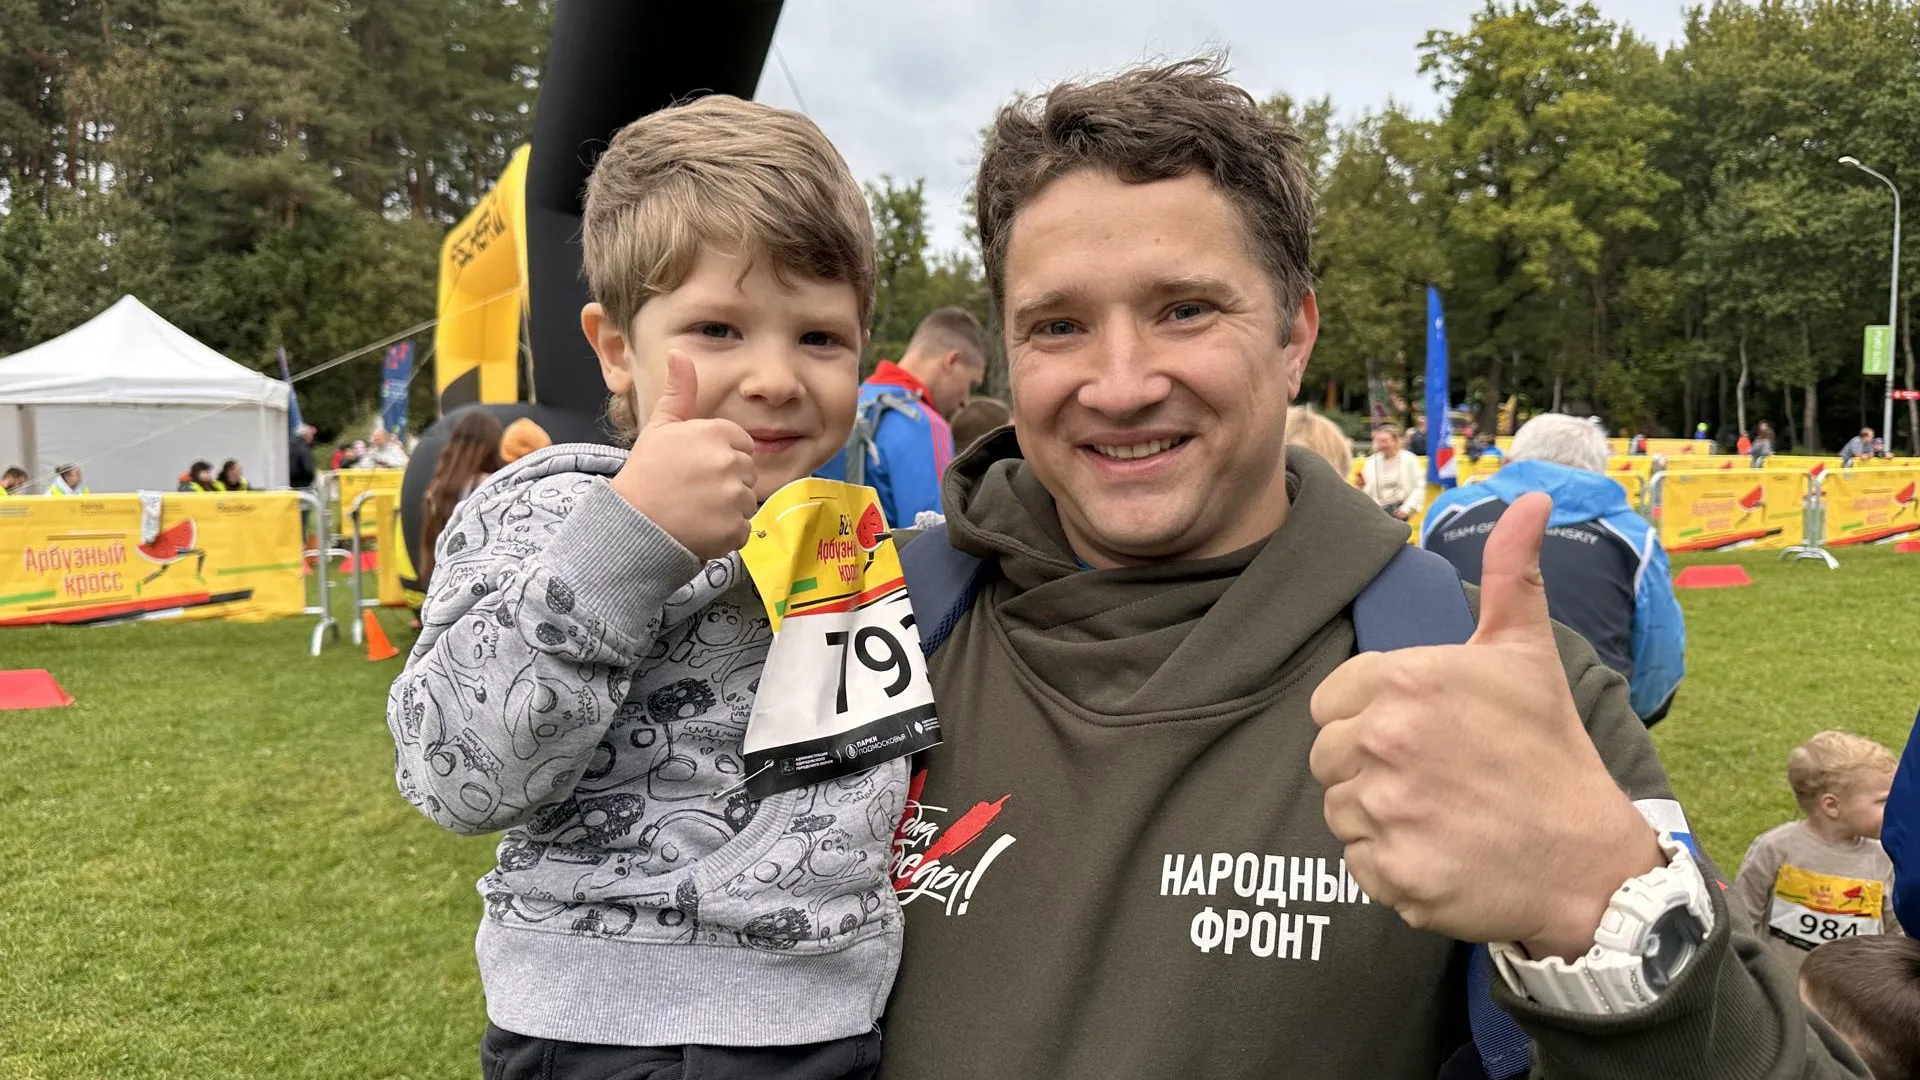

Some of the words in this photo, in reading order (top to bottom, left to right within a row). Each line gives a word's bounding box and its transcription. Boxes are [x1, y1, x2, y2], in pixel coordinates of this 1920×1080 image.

[24, 540, 127, 575] Арбузный
[64, 571, 124, 598] кросс
[856, 735, 878, 748] ПАРКИ
[858, 733, 907, 756] ПОДМОСКОВЬЯ
[1190, 906, 1331, 961] ФРОНТ
[1799, 914, 1858, 941] 984
